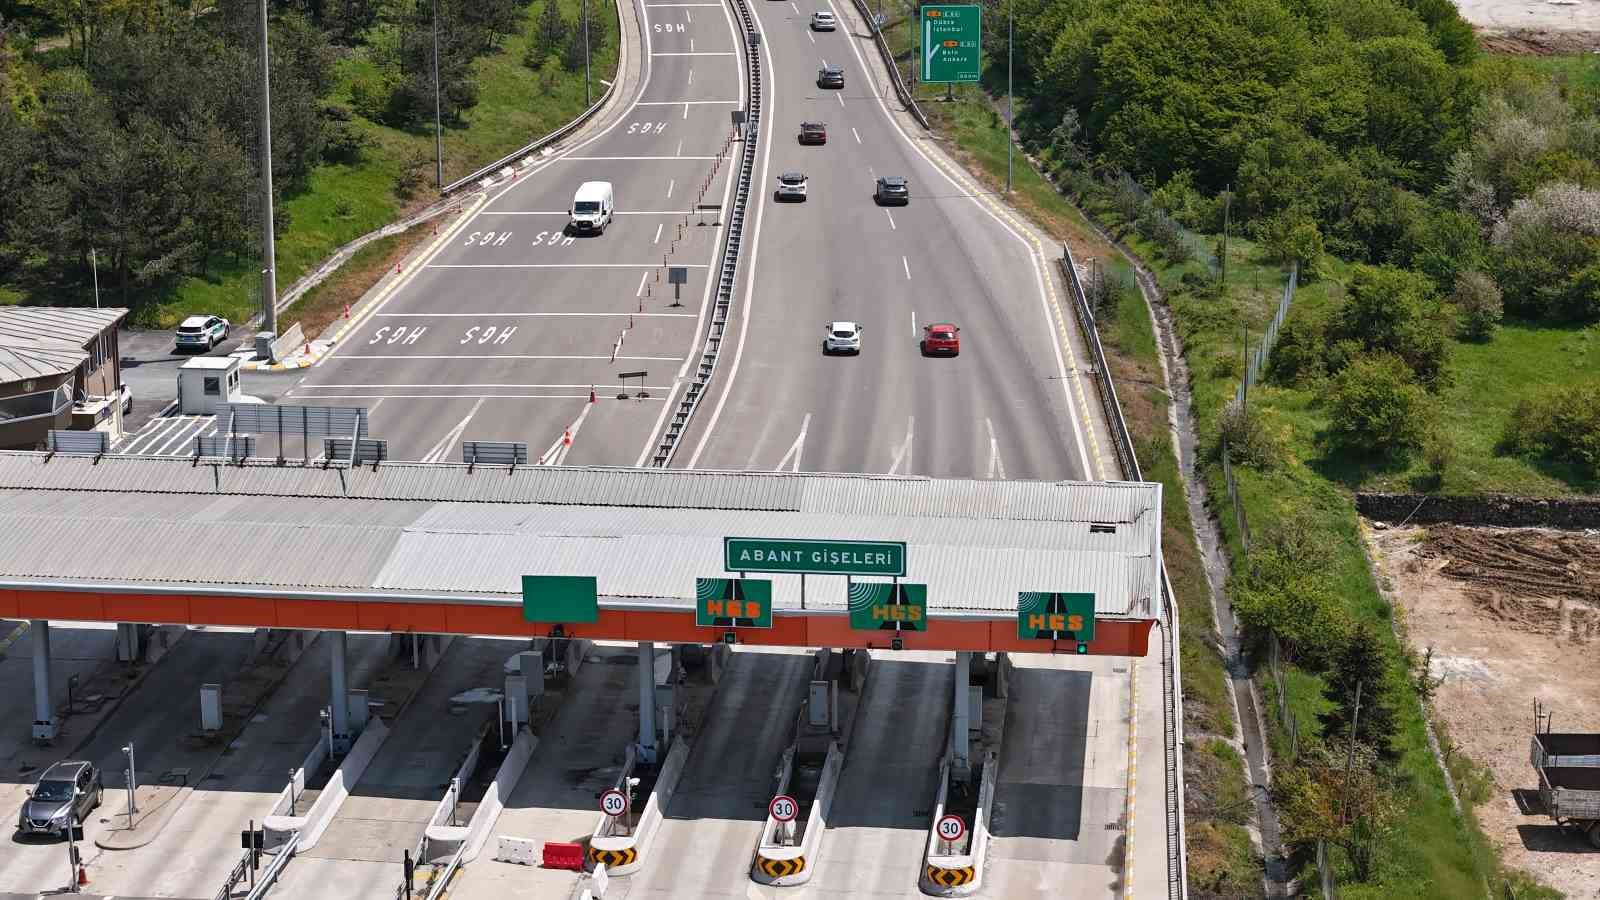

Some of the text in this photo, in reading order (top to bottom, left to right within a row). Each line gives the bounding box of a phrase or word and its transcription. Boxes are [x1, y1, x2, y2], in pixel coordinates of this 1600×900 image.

[654, 23, 685, 33] HGS
[627, 122, 667, 134] HGS
[464, 231, 513, 246] HGS
[368, 326, 427, 344] HGS
[460, 326, 518, 344] HGS
[740, 548, 892, 566] ABANT GİŞELERİ
[872, 604, 922, 621] HGS
[1029, 613, 1084, 631] HGS
[606, 797, 622, 810] 30
[775, 803, 793, 816] 30
[942, 822, 959, 834] 30
